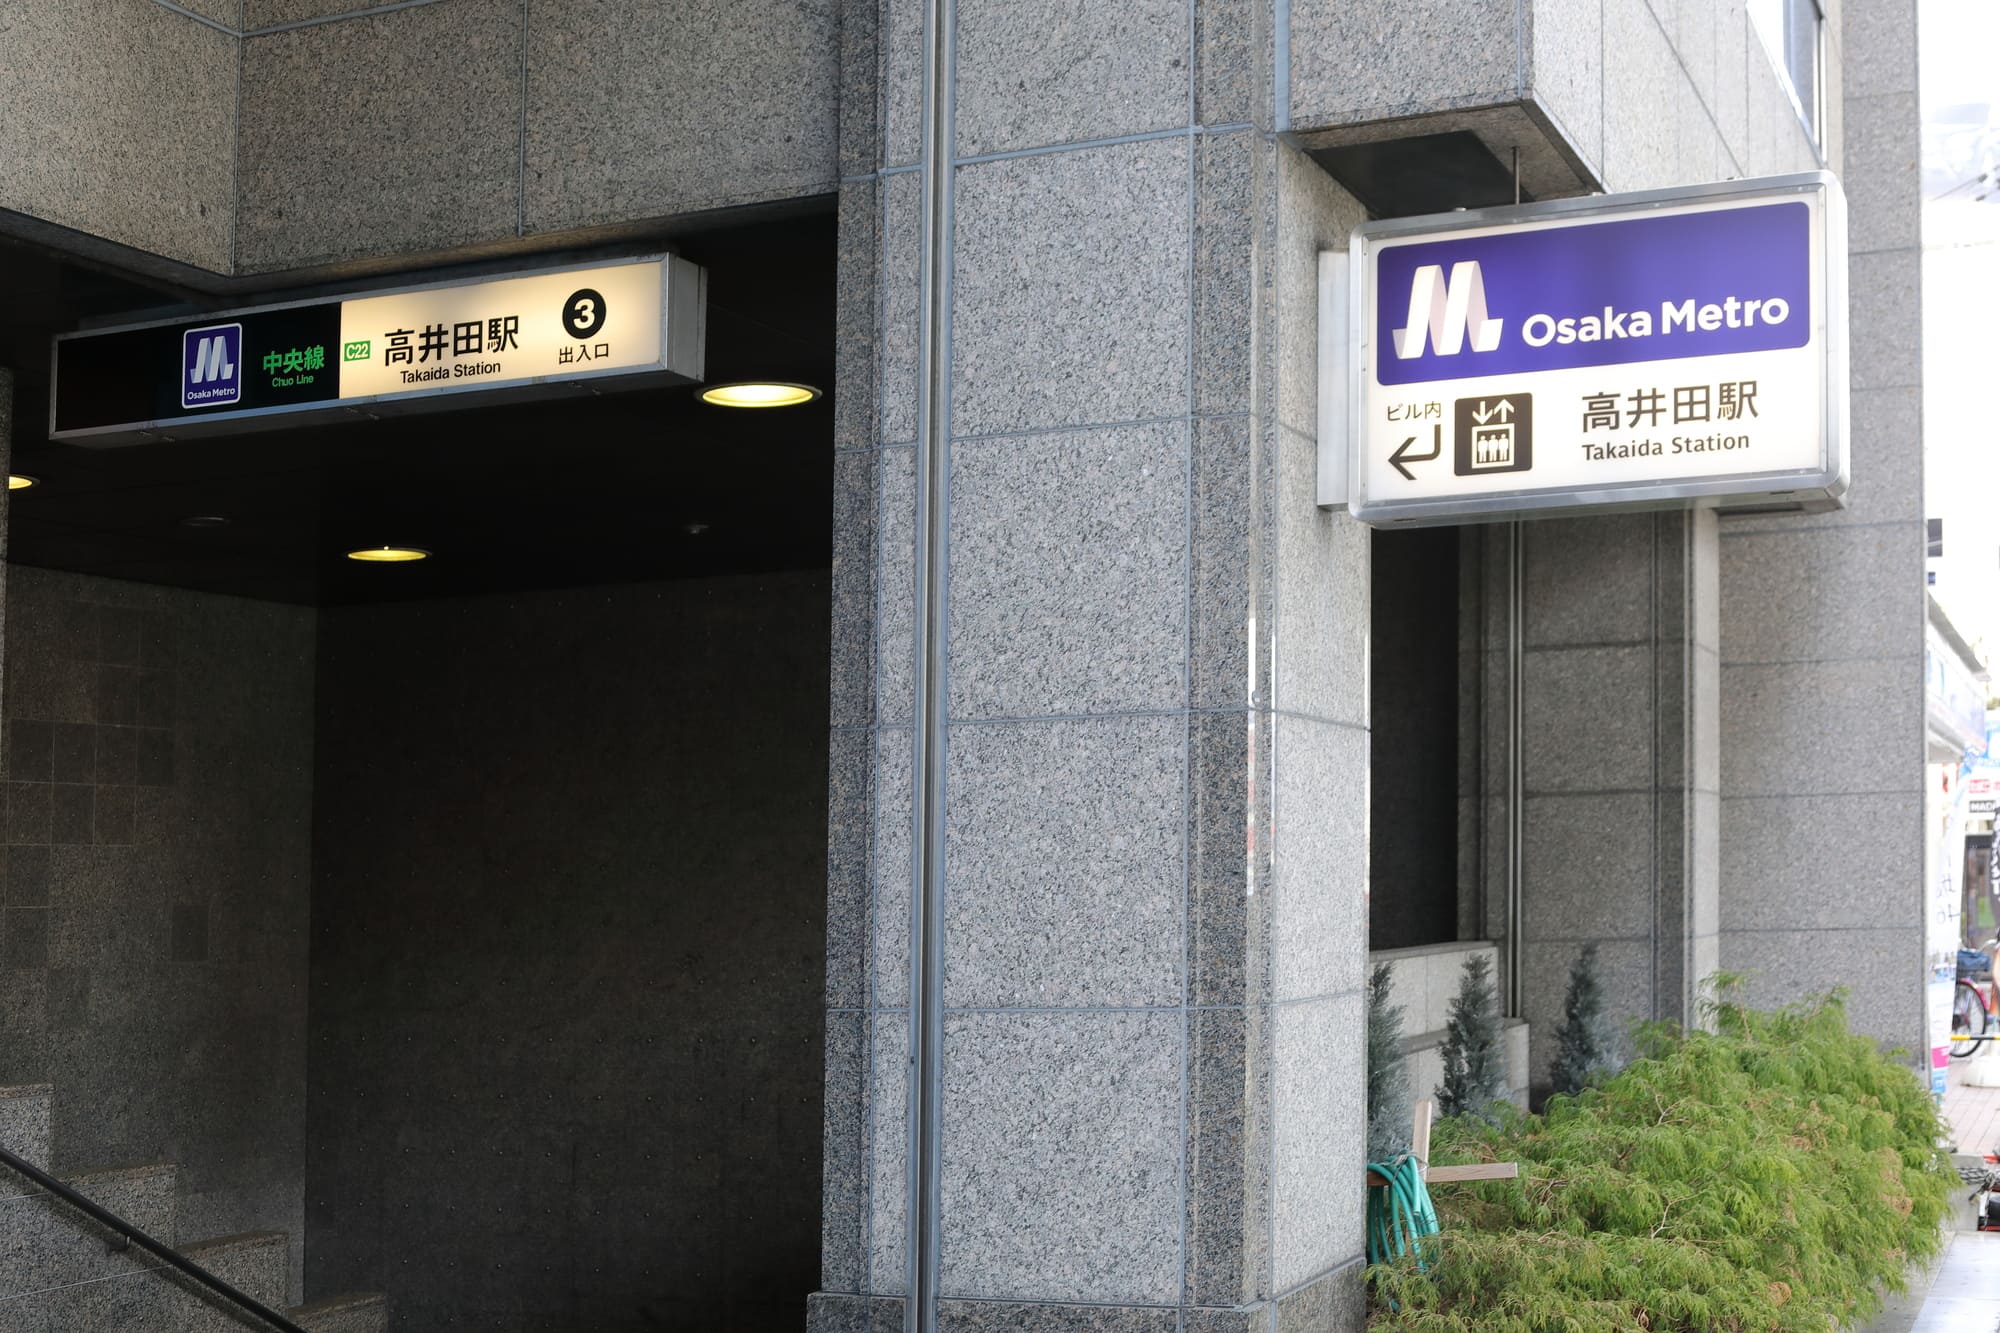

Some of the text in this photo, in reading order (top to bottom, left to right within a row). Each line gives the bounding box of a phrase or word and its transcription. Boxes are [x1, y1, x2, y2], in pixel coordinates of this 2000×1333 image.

[573, 298, 596, 329] 3
[1522, 296, 1790, 347] Osaka Metro
[346, 343, 369, 359] C22
[384, 315, 519, 367] 高井田駅
[263, 344, 325, 375] 中央線
[558, 343, 609, 365] 出入口
[272, 374, 314, 387] Chuo Line
[400, 361, 501, 384] Takaida Station
[187, 387, 236, 400] Osaka Metro
[1387, 401, 1442, 421] ビル内
[1582, 380, 1759, 433] 高井田駅
[1582, 433, 1750, 461] Takaida Station
